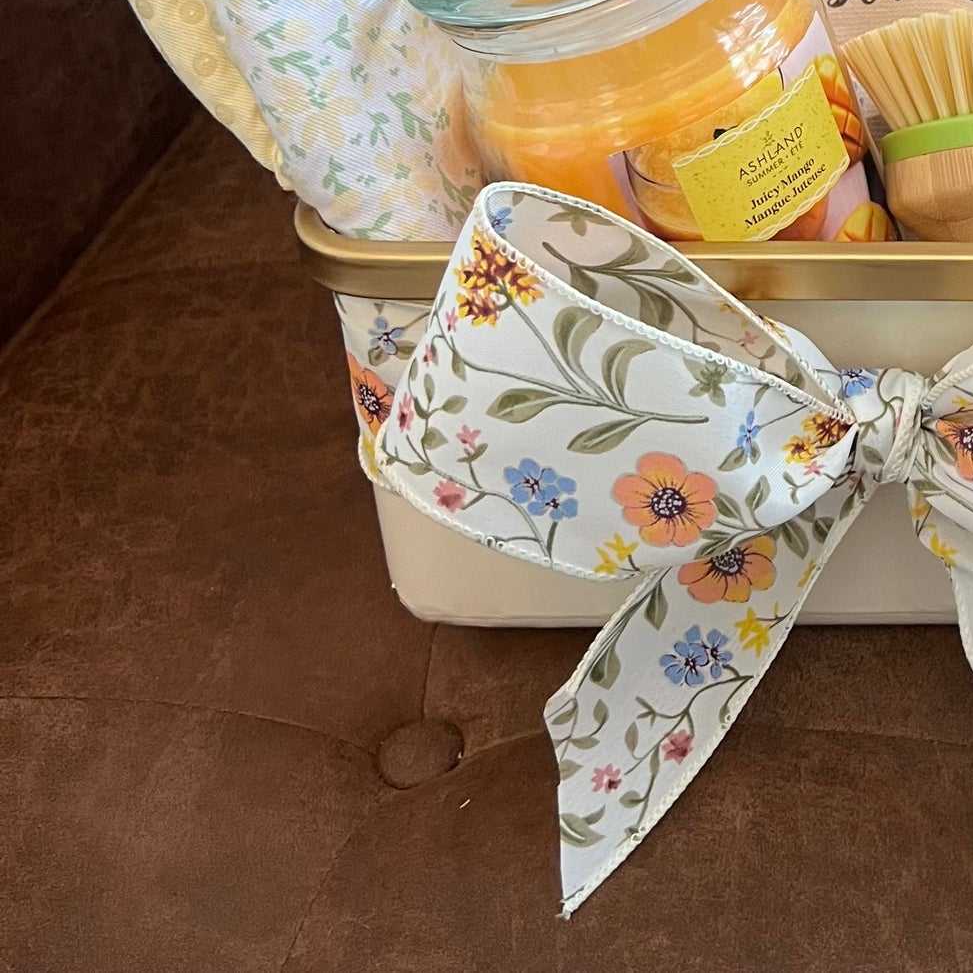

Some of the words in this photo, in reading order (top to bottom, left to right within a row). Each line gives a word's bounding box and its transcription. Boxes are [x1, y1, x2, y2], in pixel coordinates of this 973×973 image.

[739, 126, 804, 180] ASHLAND
[746, 158, 785, 187] SUMMER
[744, 194, 791, 229] Mangue
[792, 163, 827, 198] Juteuse
[750, 185, 780, 210] Juicy
[780, 158, 815, 189] Mango
